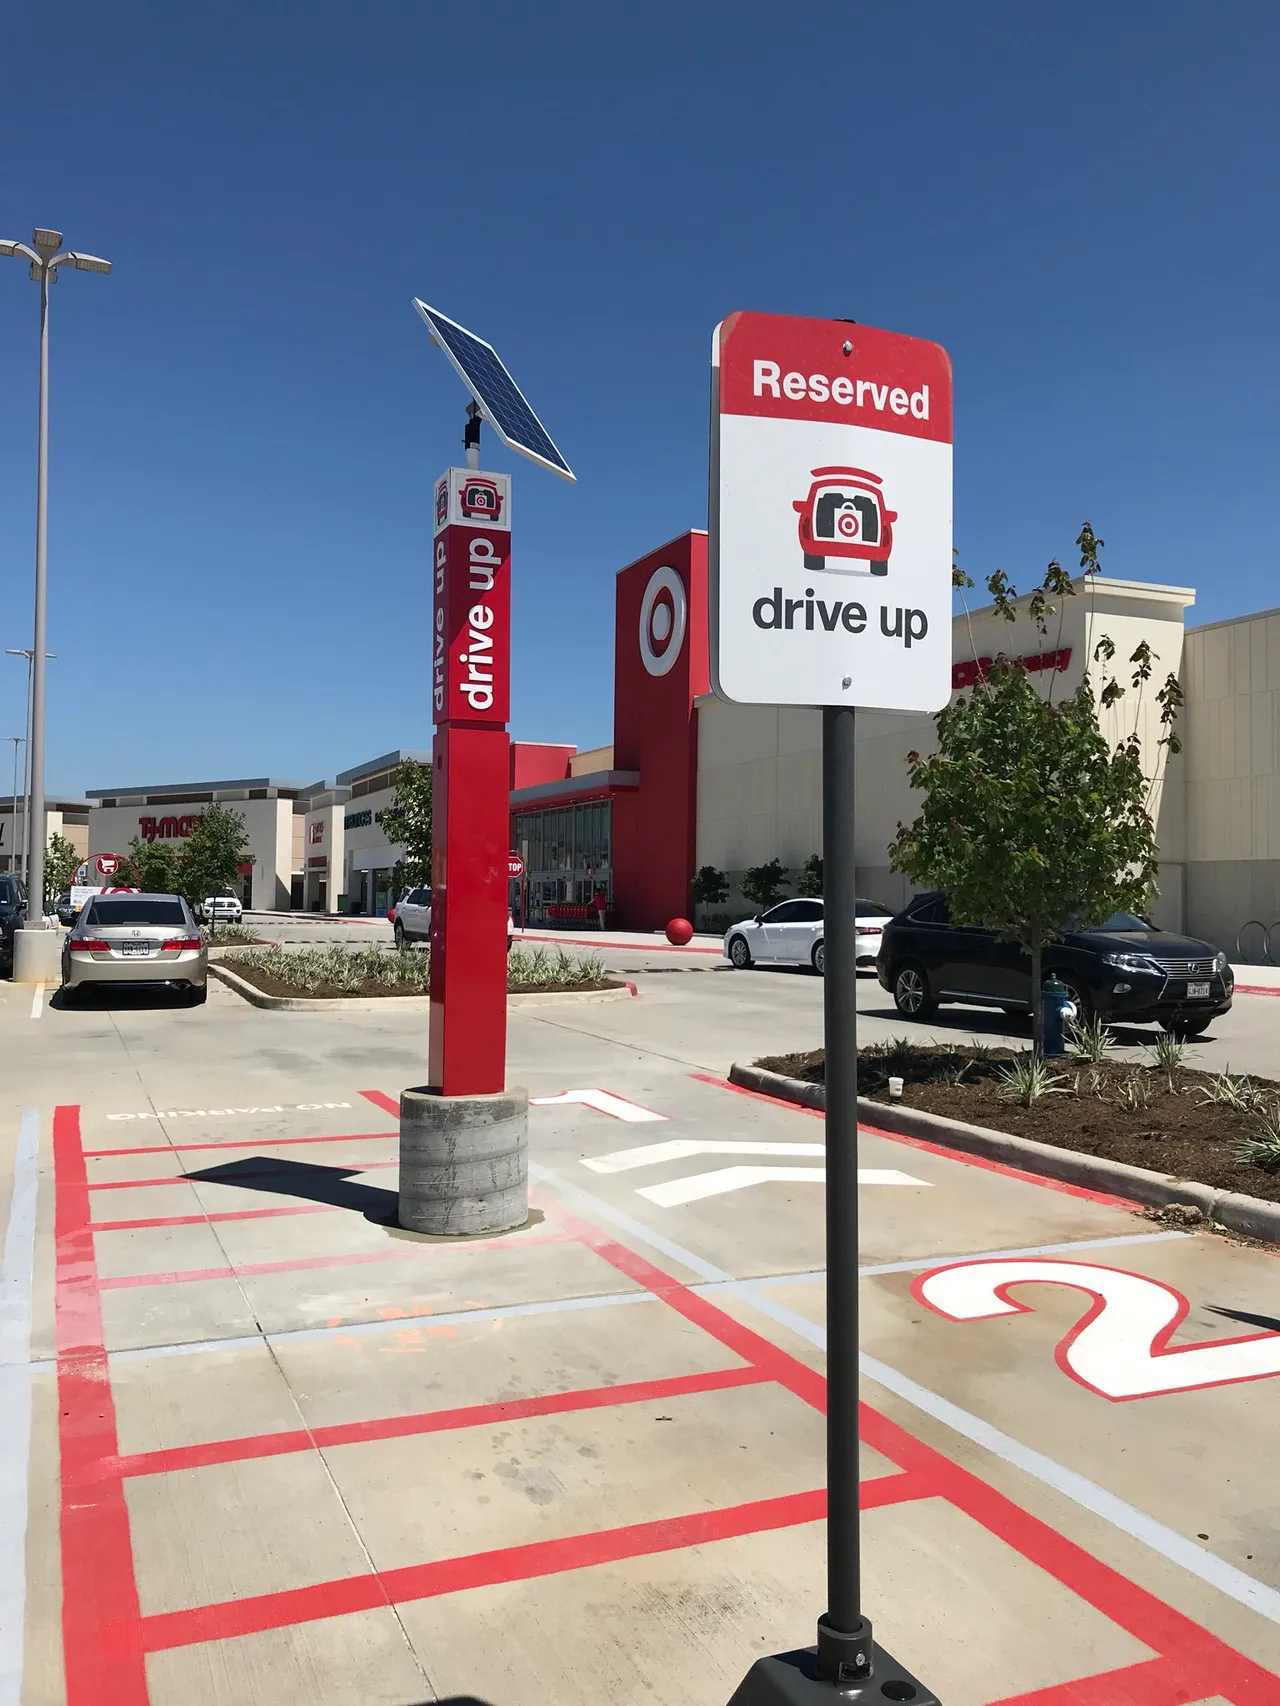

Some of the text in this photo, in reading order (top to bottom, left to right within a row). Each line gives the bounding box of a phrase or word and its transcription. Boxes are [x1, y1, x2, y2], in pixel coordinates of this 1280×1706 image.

[753, 359, 930, 421] Reserved
[433, 540, 447, 711] drive up
[459, 537, 502, 711] drive up
[752, 587, 929, 648] drive up
[508, 862, 522, 872] TOP
[105, 1101, 353, 1121] NO PARKING
[910, 1258, 1280, 1403] 2
